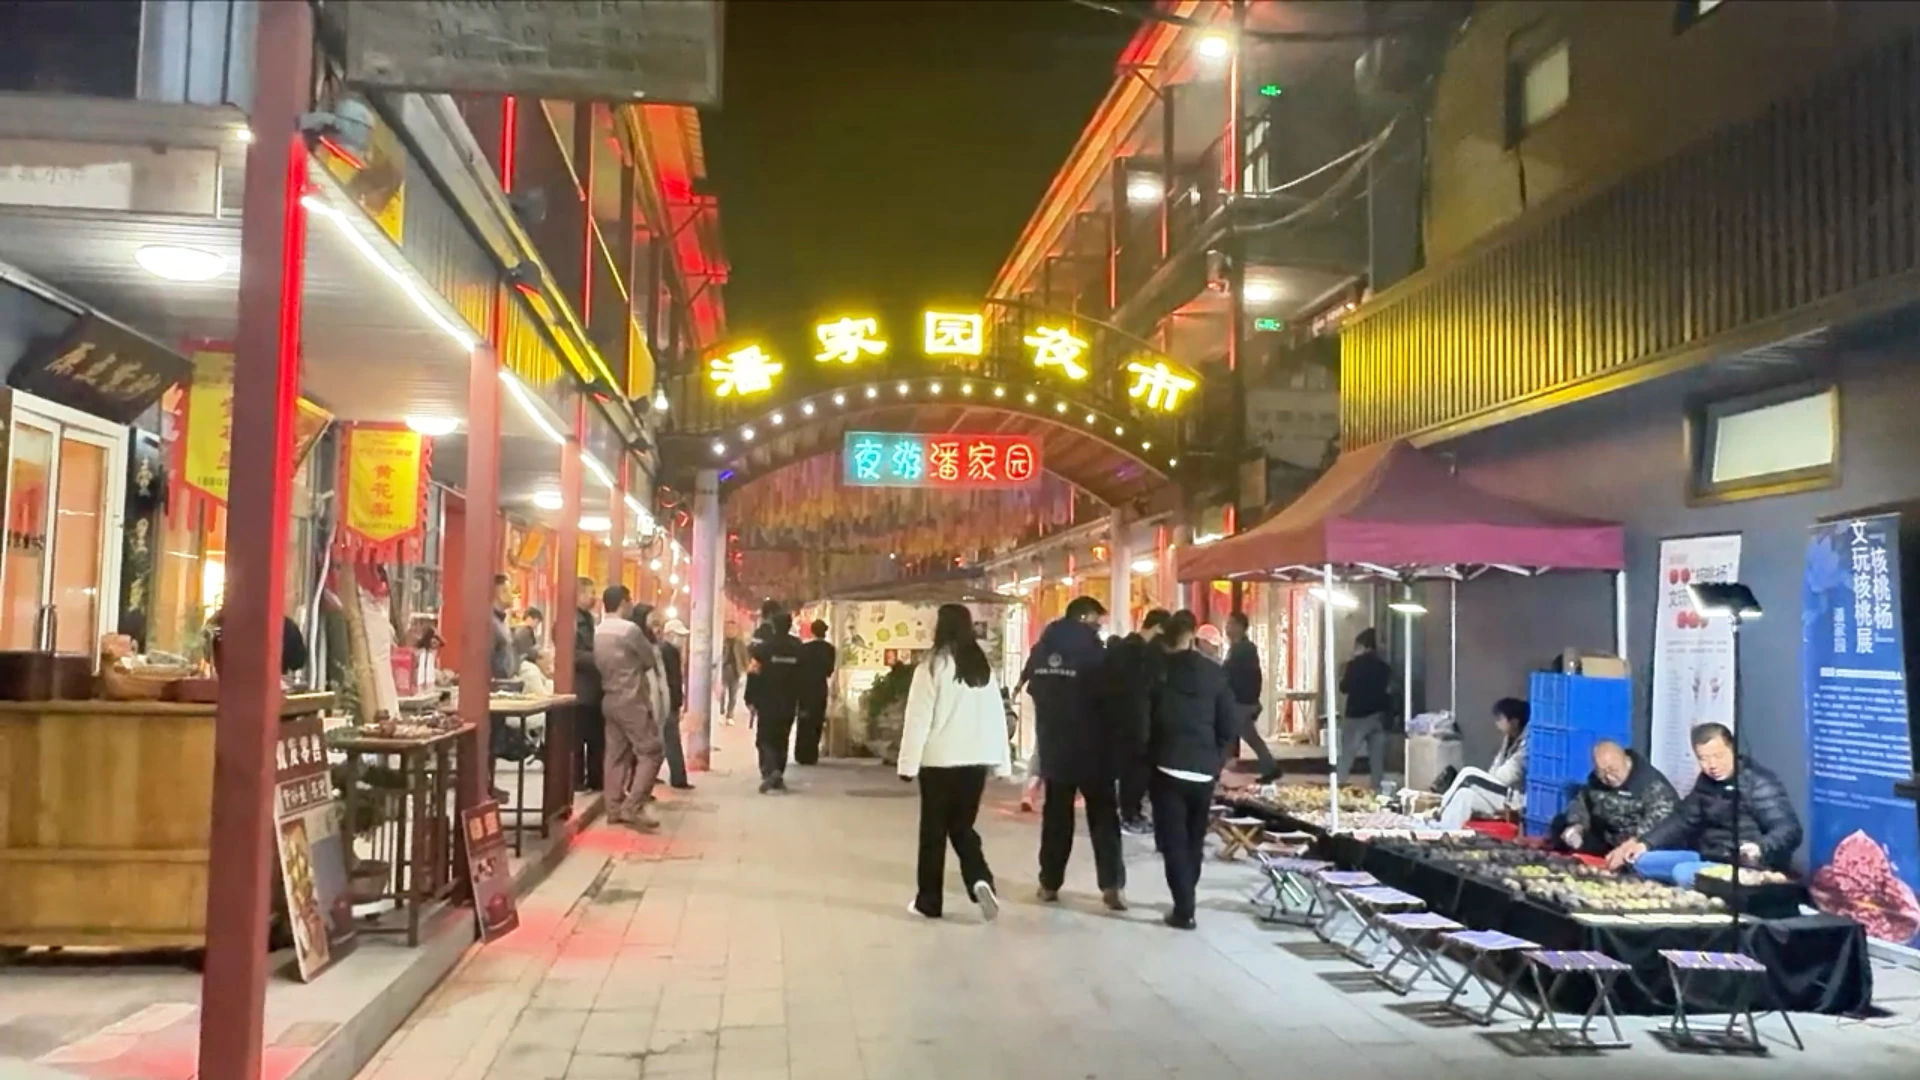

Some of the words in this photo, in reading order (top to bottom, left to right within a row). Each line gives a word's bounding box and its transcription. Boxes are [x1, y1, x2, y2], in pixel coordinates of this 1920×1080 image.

[708, 309, 1198, 412] 潘家园夜市
[852, 439, 1036, 483] 夜游潘家园
[1850, 519, 1875, 654] 文玩核桃展
